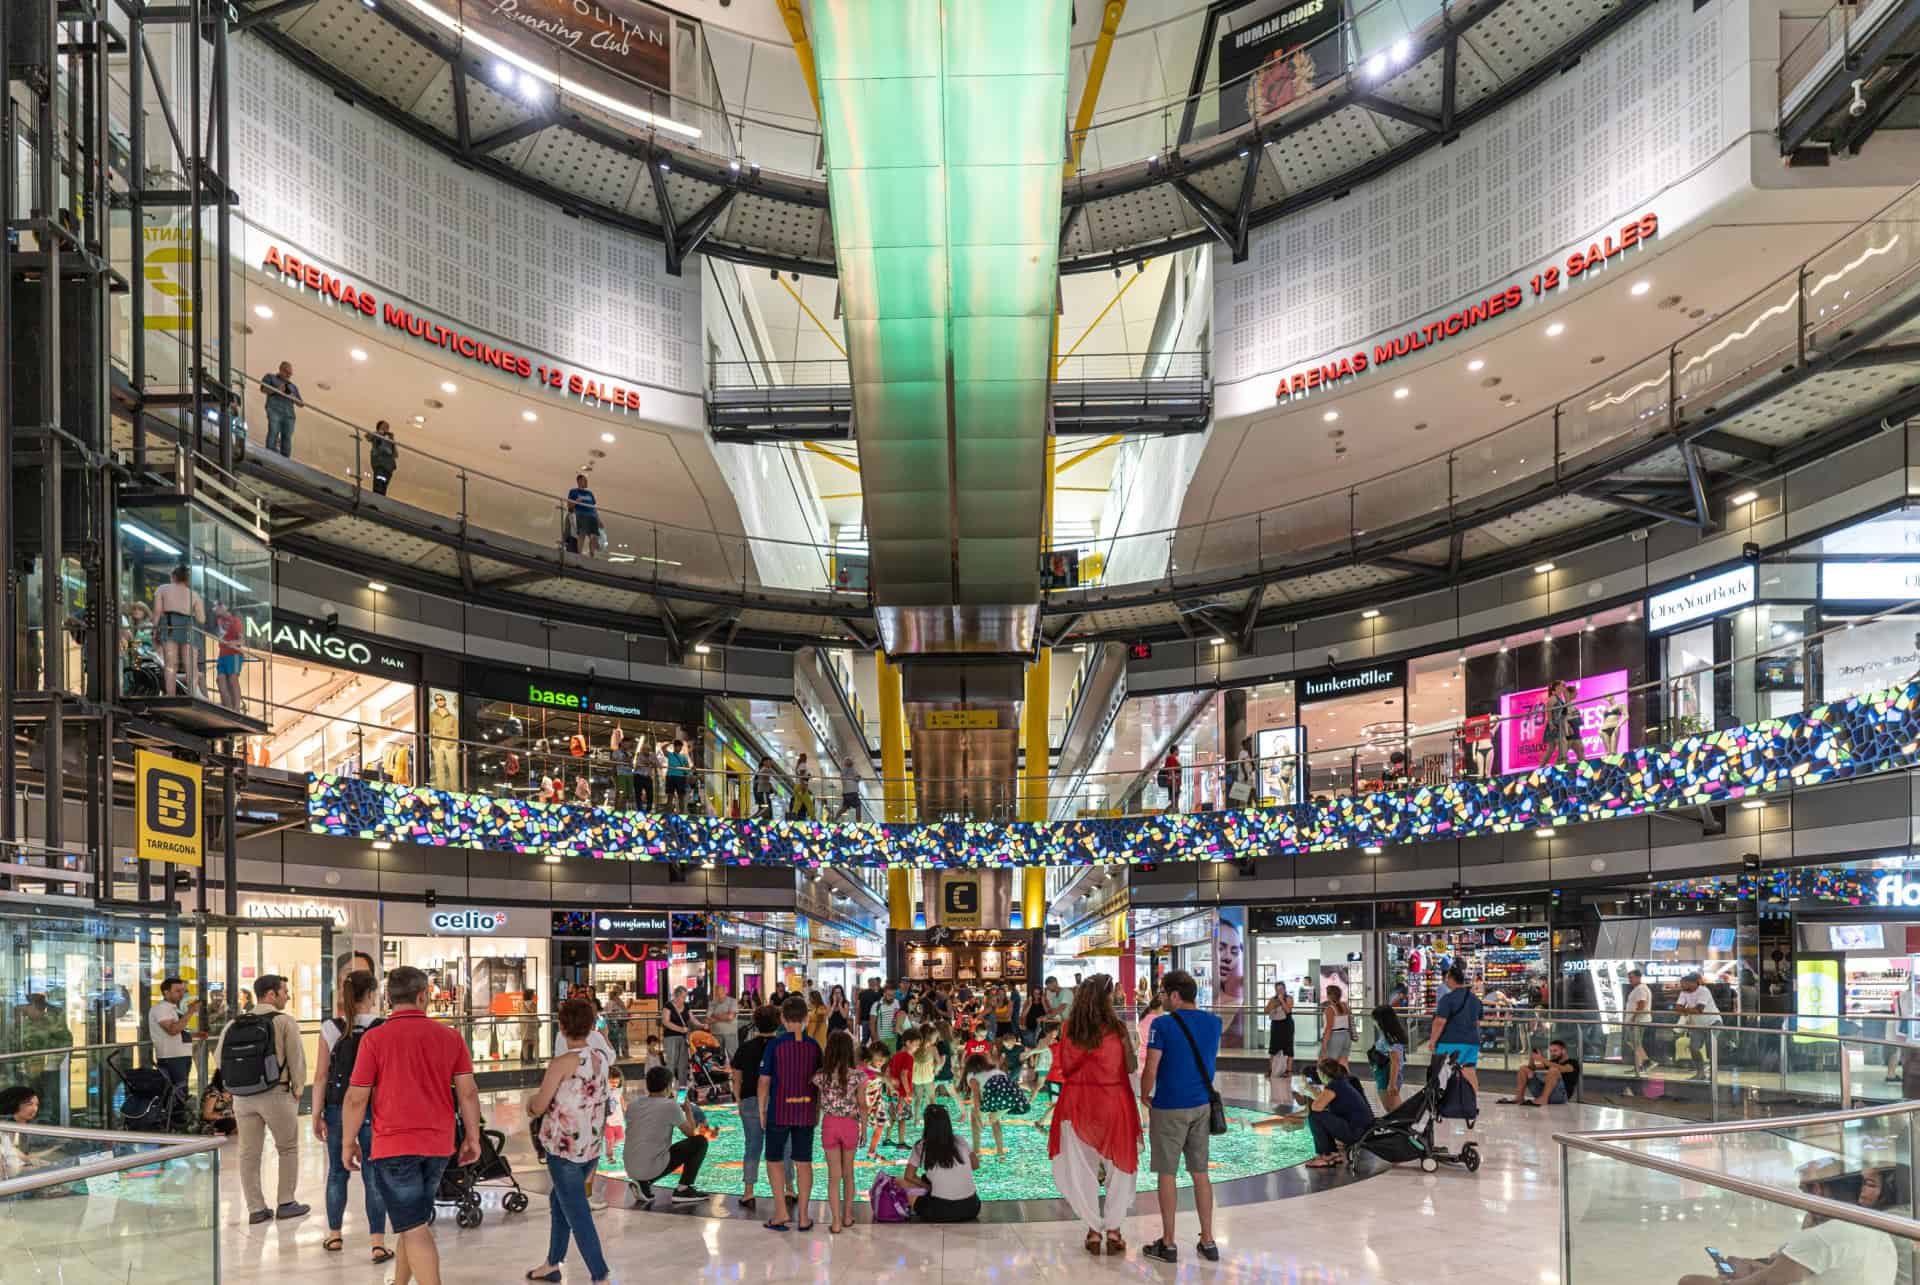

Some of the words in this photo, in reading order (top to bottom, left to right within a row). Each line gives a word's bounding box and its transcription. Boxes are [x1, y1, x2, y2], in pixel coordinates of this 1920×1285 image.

[1235, 17, 1281, 48] HUMAN
[1281, 0, 1325, 28] BODIES
[591, 30, 631, 56] Club
[1275, 351, 1368, 399] ARENAS
[1374, 286, 1522, 366] MULTICINES
[1530, 267, 1560, 295] 12
[1566, 212, 1659, 278] SALES
[263, 246, 377, 316] ARENAS
[383, 303, 532, 378] MULTICINES
[538, 365, 563, 388] 12
[569, 373, 642, 410] SALES
[246, 616, 372, 665] MANGO
[380, 656, 405, 668] MAN
[1306, 669, 1393, 695] hunkemöller
[158, 778, 187, 828] B
[146, 838, 196, 855] TARRAGONA
[953, 885, 969, 910] C
[248, 903, 345, 921] PANDORA
[1276, 913, 1337, 926] SWAROVSKI
[1442, 903, 1505, 919] camicie
[613, 919, 650, 931] sunglass
[651, 919, 666, 929] hut
